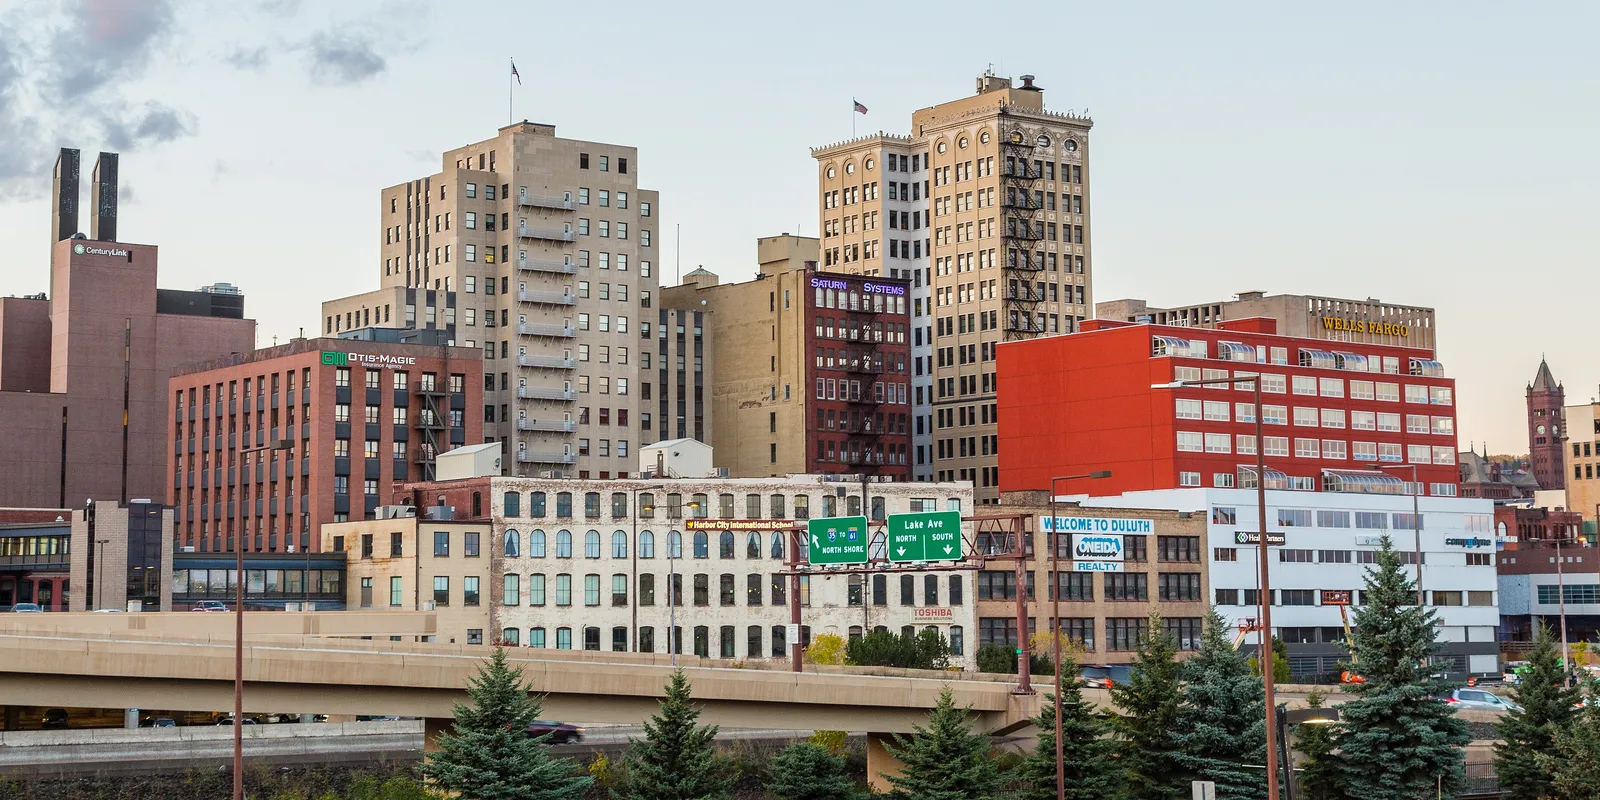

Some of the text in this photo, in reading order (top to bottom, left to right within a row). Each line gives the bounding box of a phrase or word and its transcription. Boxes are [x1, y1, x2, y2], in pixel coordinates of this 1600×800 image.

[86, 246, 127, 256] CenturyLink
[1323, 317, 1409, 337] WELLS FARGO
[694, 521, 794, 530] Harbor City International School
[904, 519, 943, 530] Lake Ave
[1044, 517, 1150, 532] WELCOME TO DULUTH
[849, 532, 856, 540] 61
[895, 533, 953, 543] NORTH SOUTH
[822, 545, 864, 554] NORTH SHORE
[1077, 538, 1120, 554] ONEIDA
[1078, 562, 1118, 571] REALTY
[913, 608, 953, 617] TOSHIBA
